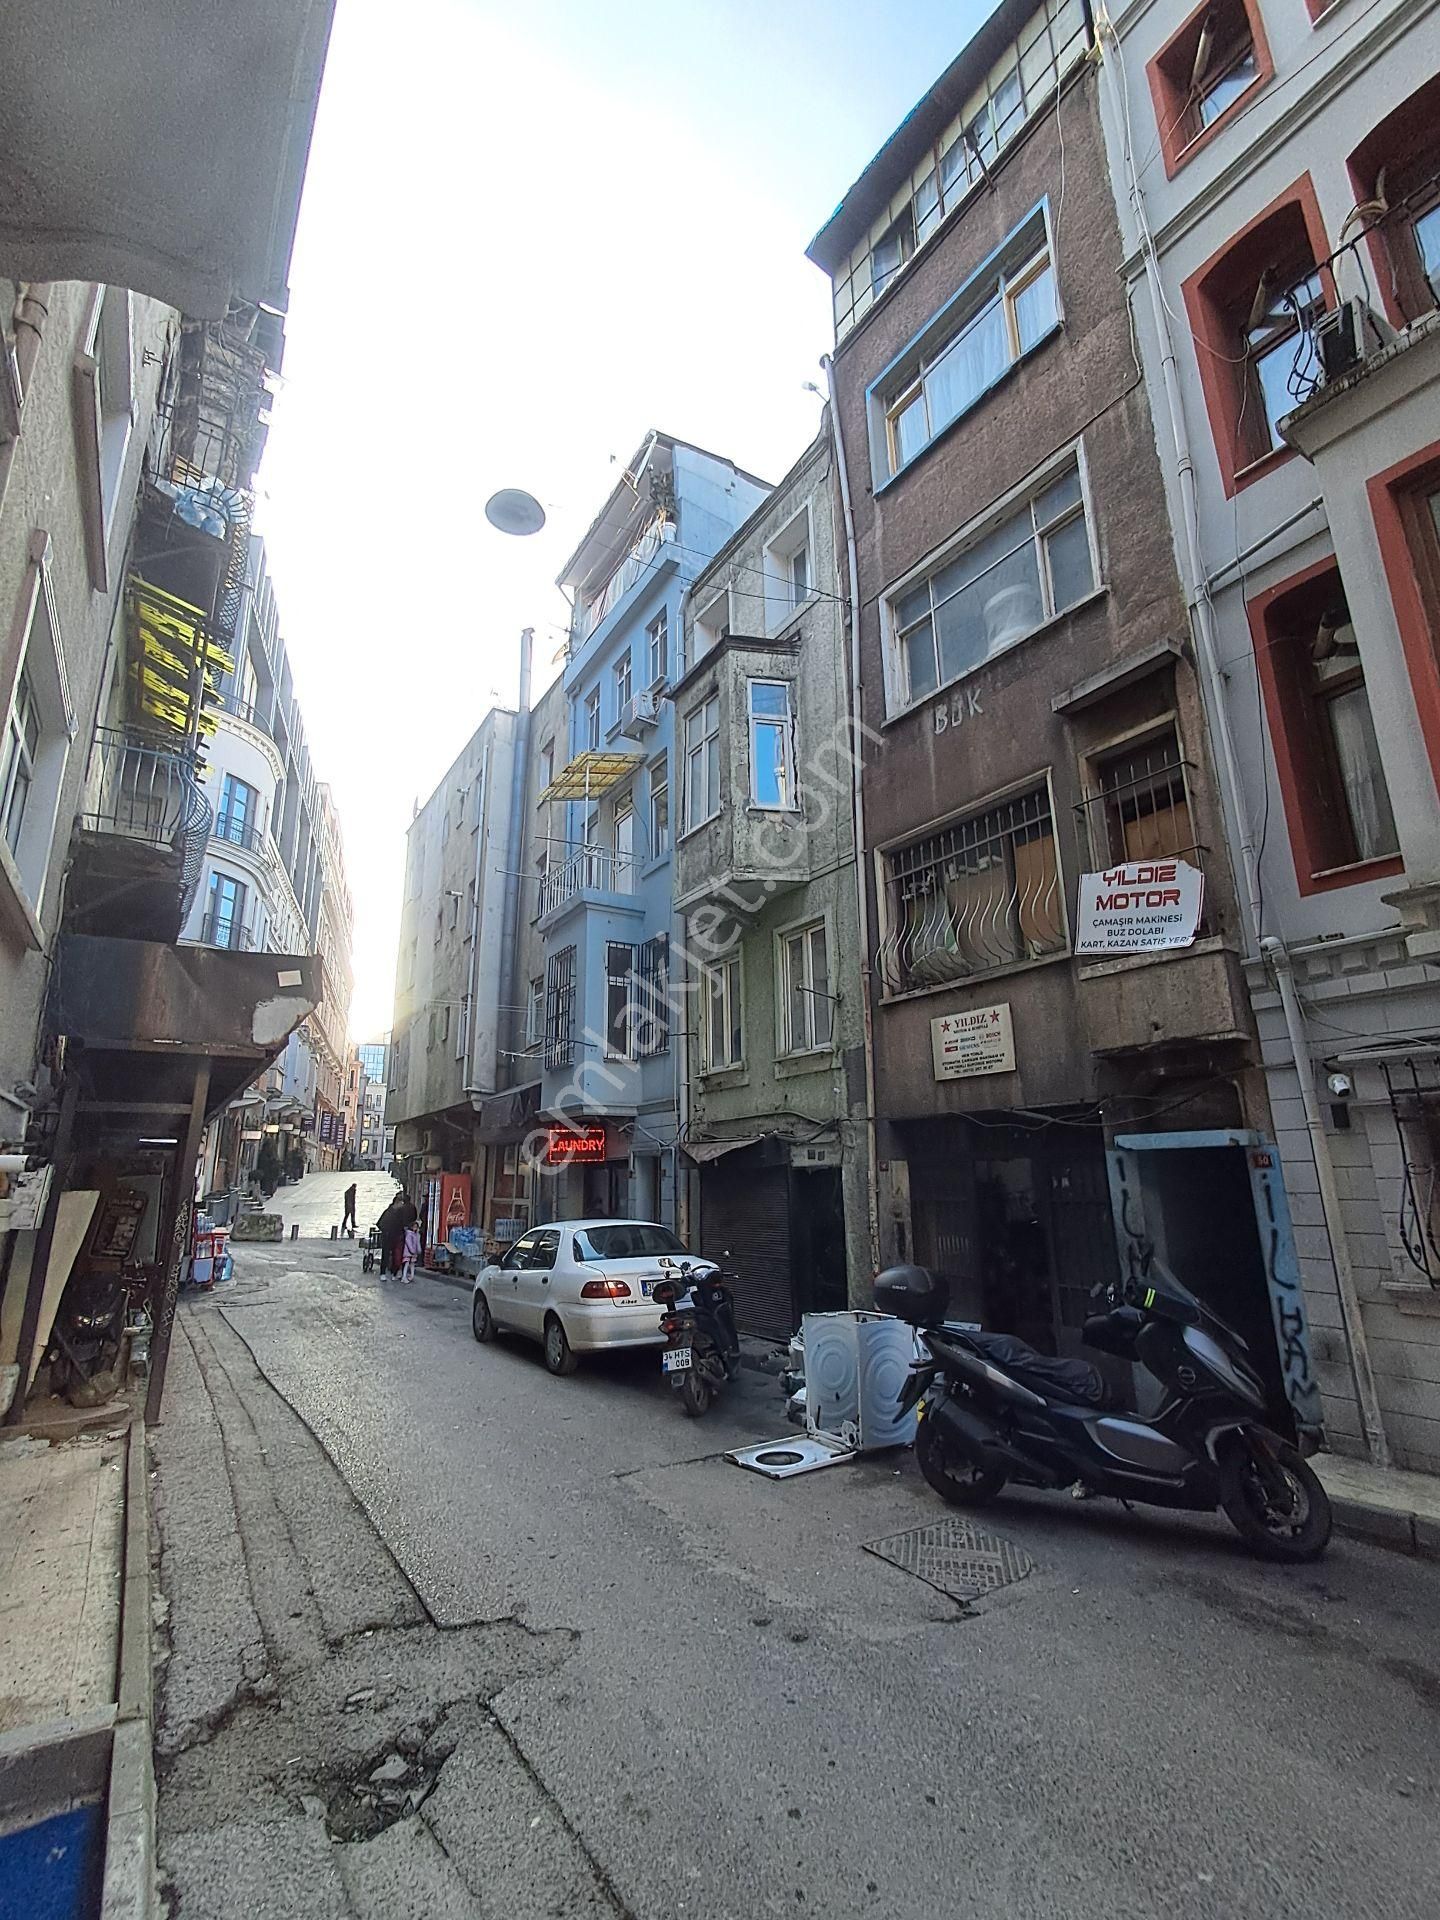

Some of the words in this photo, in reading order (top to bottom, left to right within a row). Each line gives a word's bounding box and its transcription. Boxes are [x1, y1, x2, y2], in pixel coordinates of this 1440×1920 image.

[1102, 864, 1177, 887] YILDIZ
[1095, 888, 1181, 911] MOTOR
[1092, 917, 1133, 928] ÇAMAŞIR
[1135, 913, 1183, 924] MAKİNESİ
[1107, 928, 1126, 937] BUZ
[1127, 926, 1164, 936] DOLABI
[1107, 939, 1138, 948] KAZAN
[954, 1013, 987, 1028] YILDIZ
[550, 1139, 604, 1152] LAUNDRY
